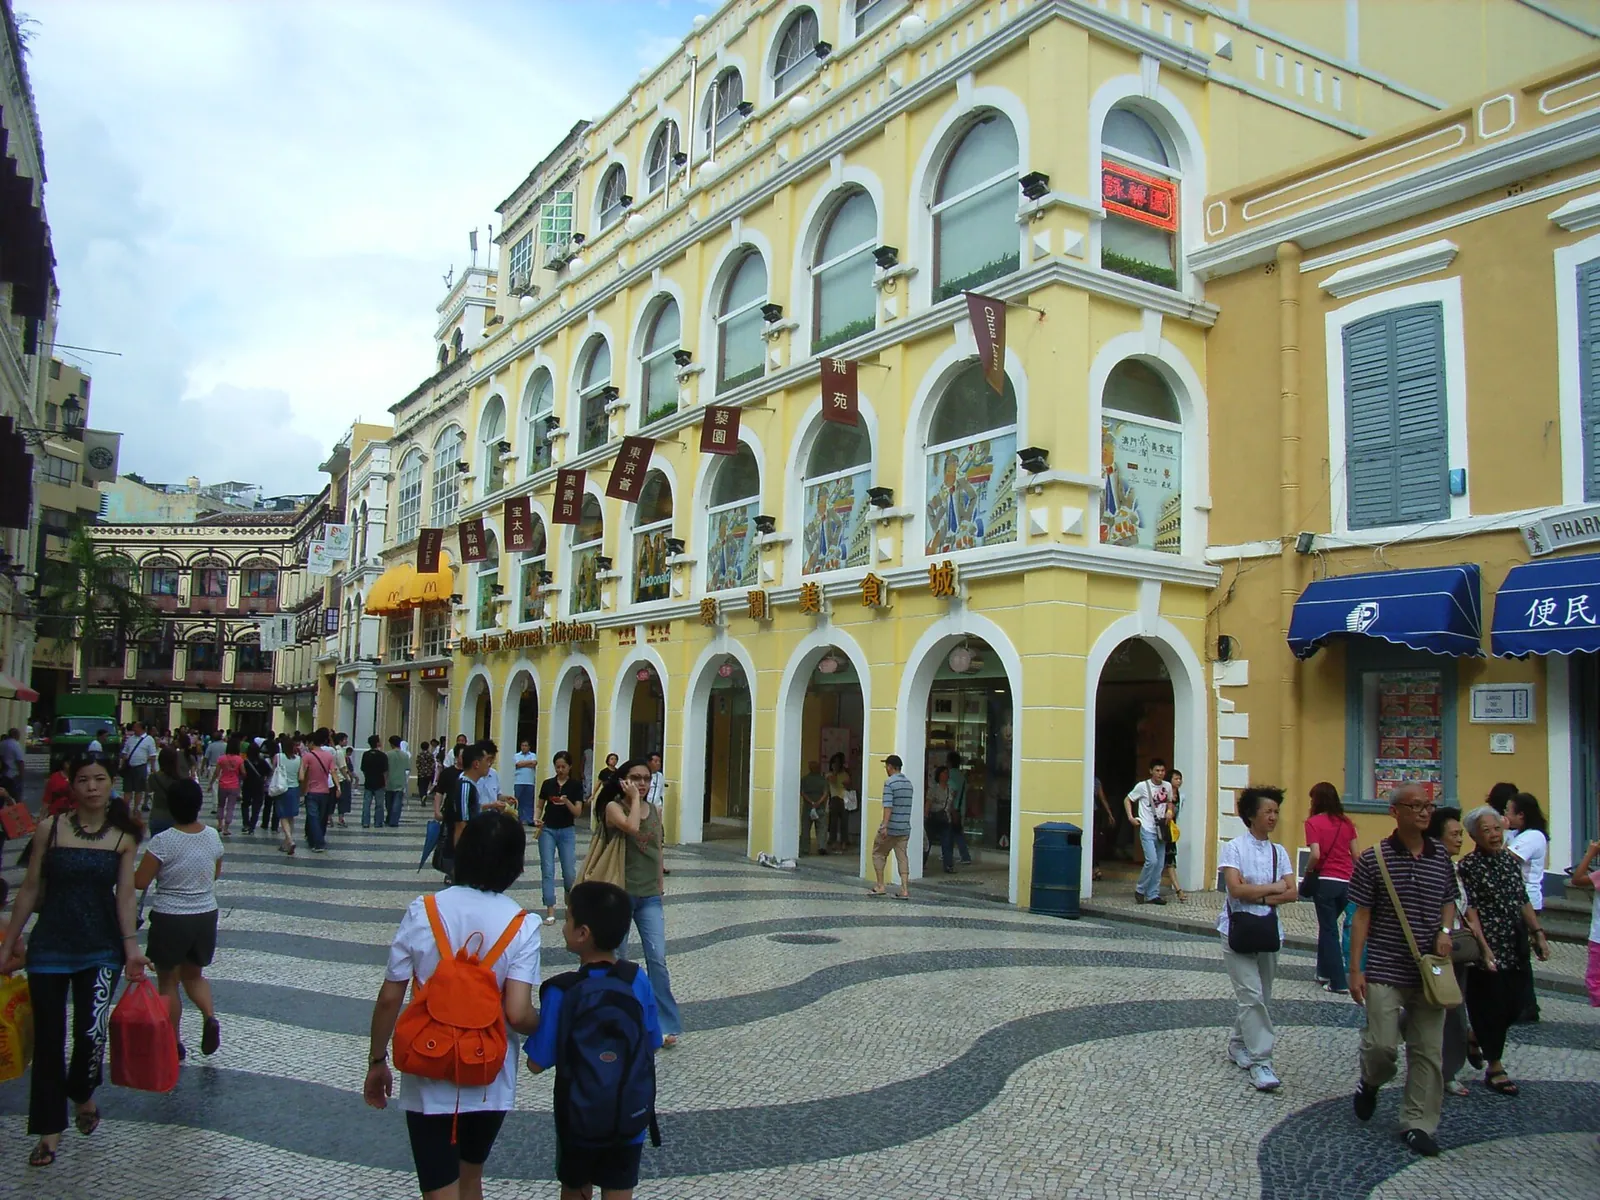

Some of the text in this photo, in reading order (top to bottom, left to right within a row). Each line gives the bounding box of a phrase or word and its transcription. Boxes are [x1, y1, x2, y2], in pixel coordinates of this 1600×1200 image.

[984, 306, 1000, 371] Chua Lam
[832, 359, 847, 410] 飛苑
[512, 506, 524, 545] 宝太郎
[1524, 594, 1596, 627] 便民
[504, 625, 543, 649] Gourmet
[551, 619, 592, 644] Kitchen
[233, 699, 264, 708] ebase
